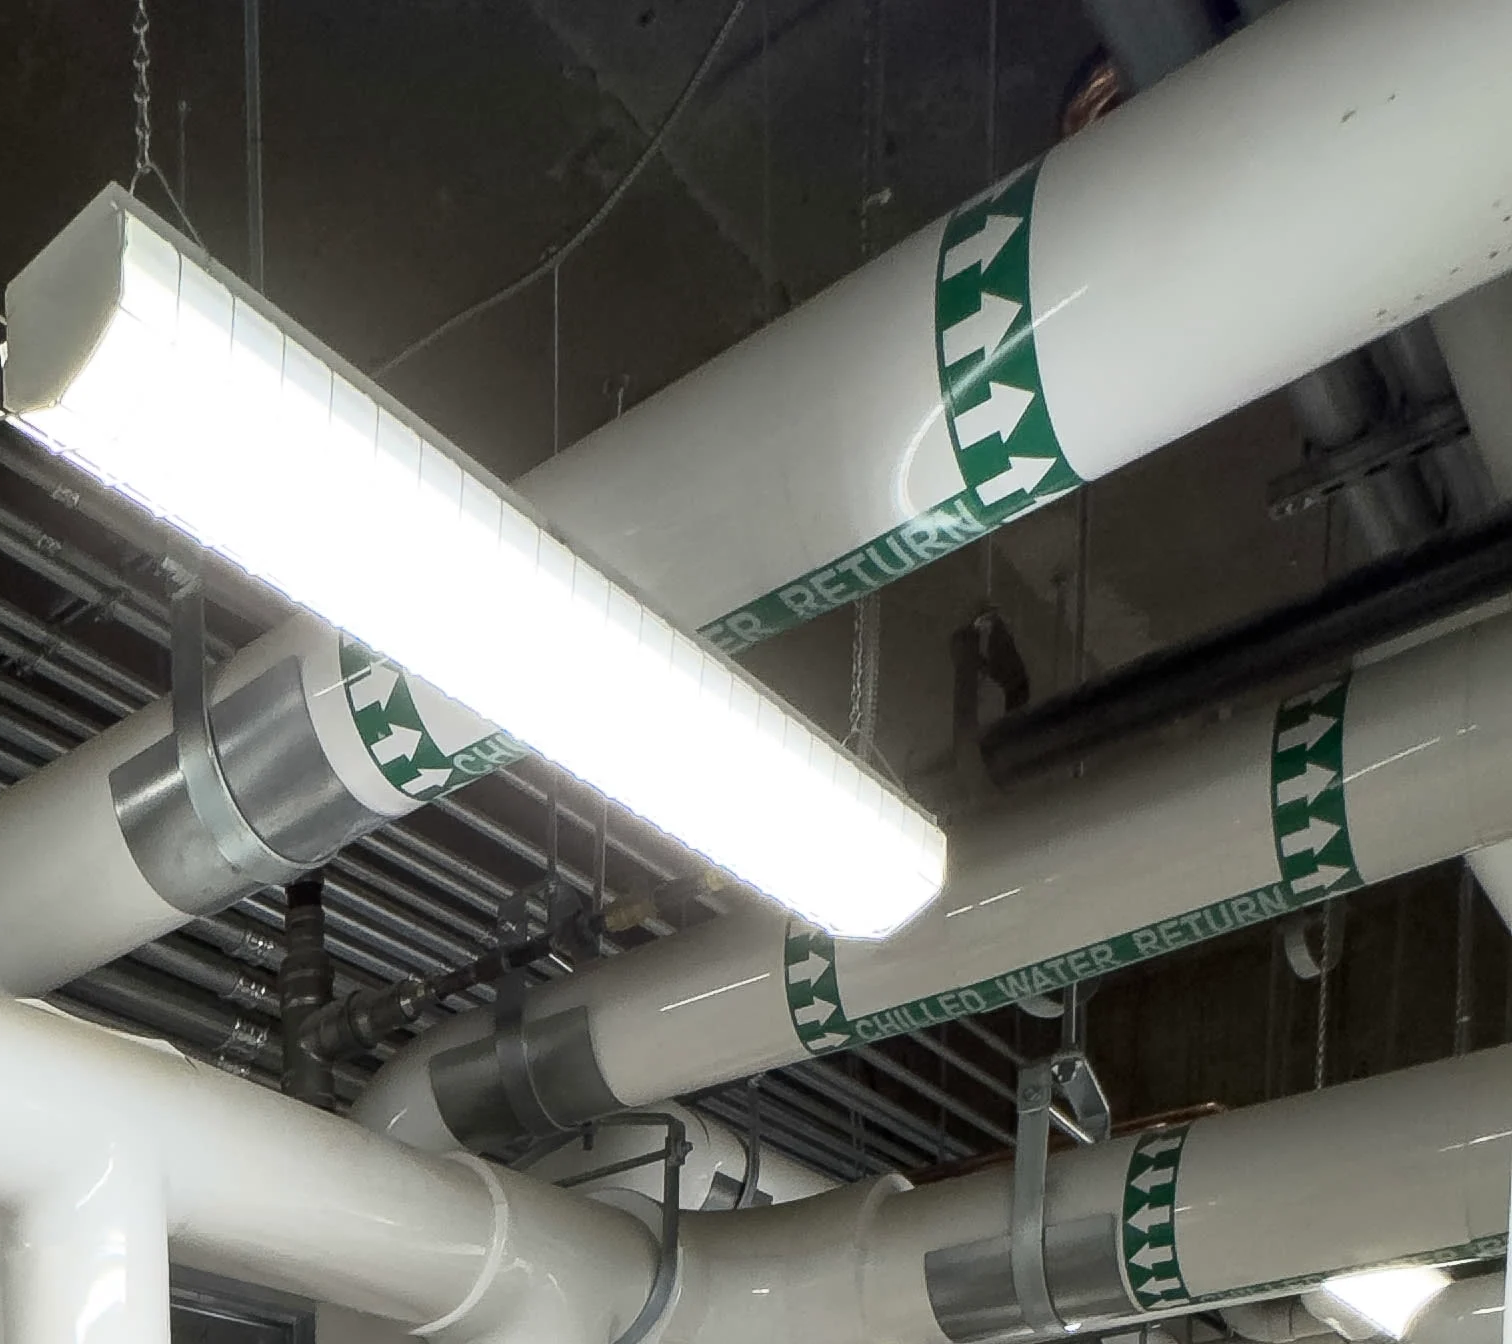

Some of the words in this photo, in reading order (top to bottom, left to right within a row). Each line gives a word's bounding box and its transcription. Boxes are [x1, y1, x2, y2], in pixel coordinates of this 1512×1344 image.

[778, 499, 989, 619] RETURN
[855, 989, 987, 1041] CHILLED
[996, 944, 1120, 1000] WATER
[1132, 887, 1287, 957] RETURN
